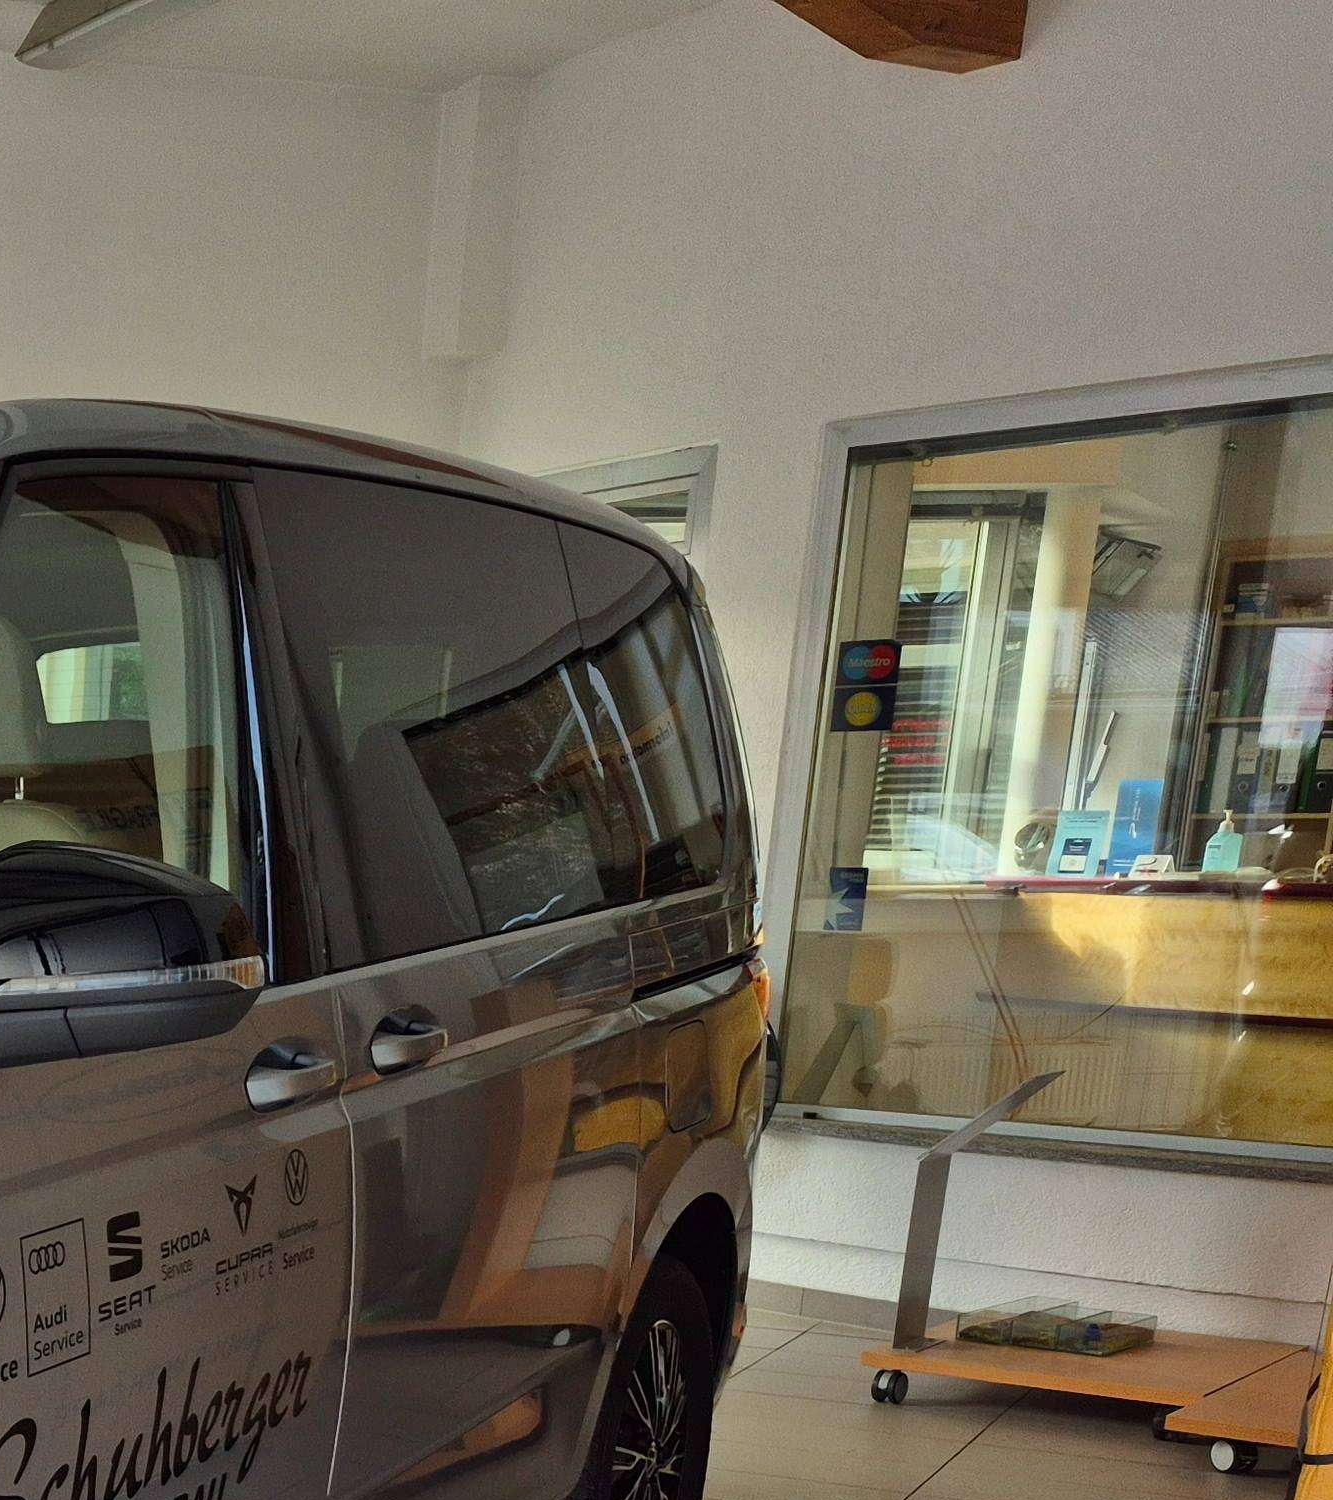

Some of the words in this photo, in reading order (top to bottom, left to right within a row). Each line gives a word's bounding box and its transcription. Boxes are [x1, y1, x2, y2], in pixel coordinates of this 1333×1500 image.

[161, 1259, 194, 1281] Service
[215, 1242, 274, 1275] CUPRA
[283, 1246, 315, 1270] Service
[215, 1261, 275, 1296] SERVICE
[98, 1285, 156, 1322] SEAT
[33, 1304, 69, 1333] Audi
[114, 1317, 143, 1336] Service
[33, 1330, 84, 1360] Service
